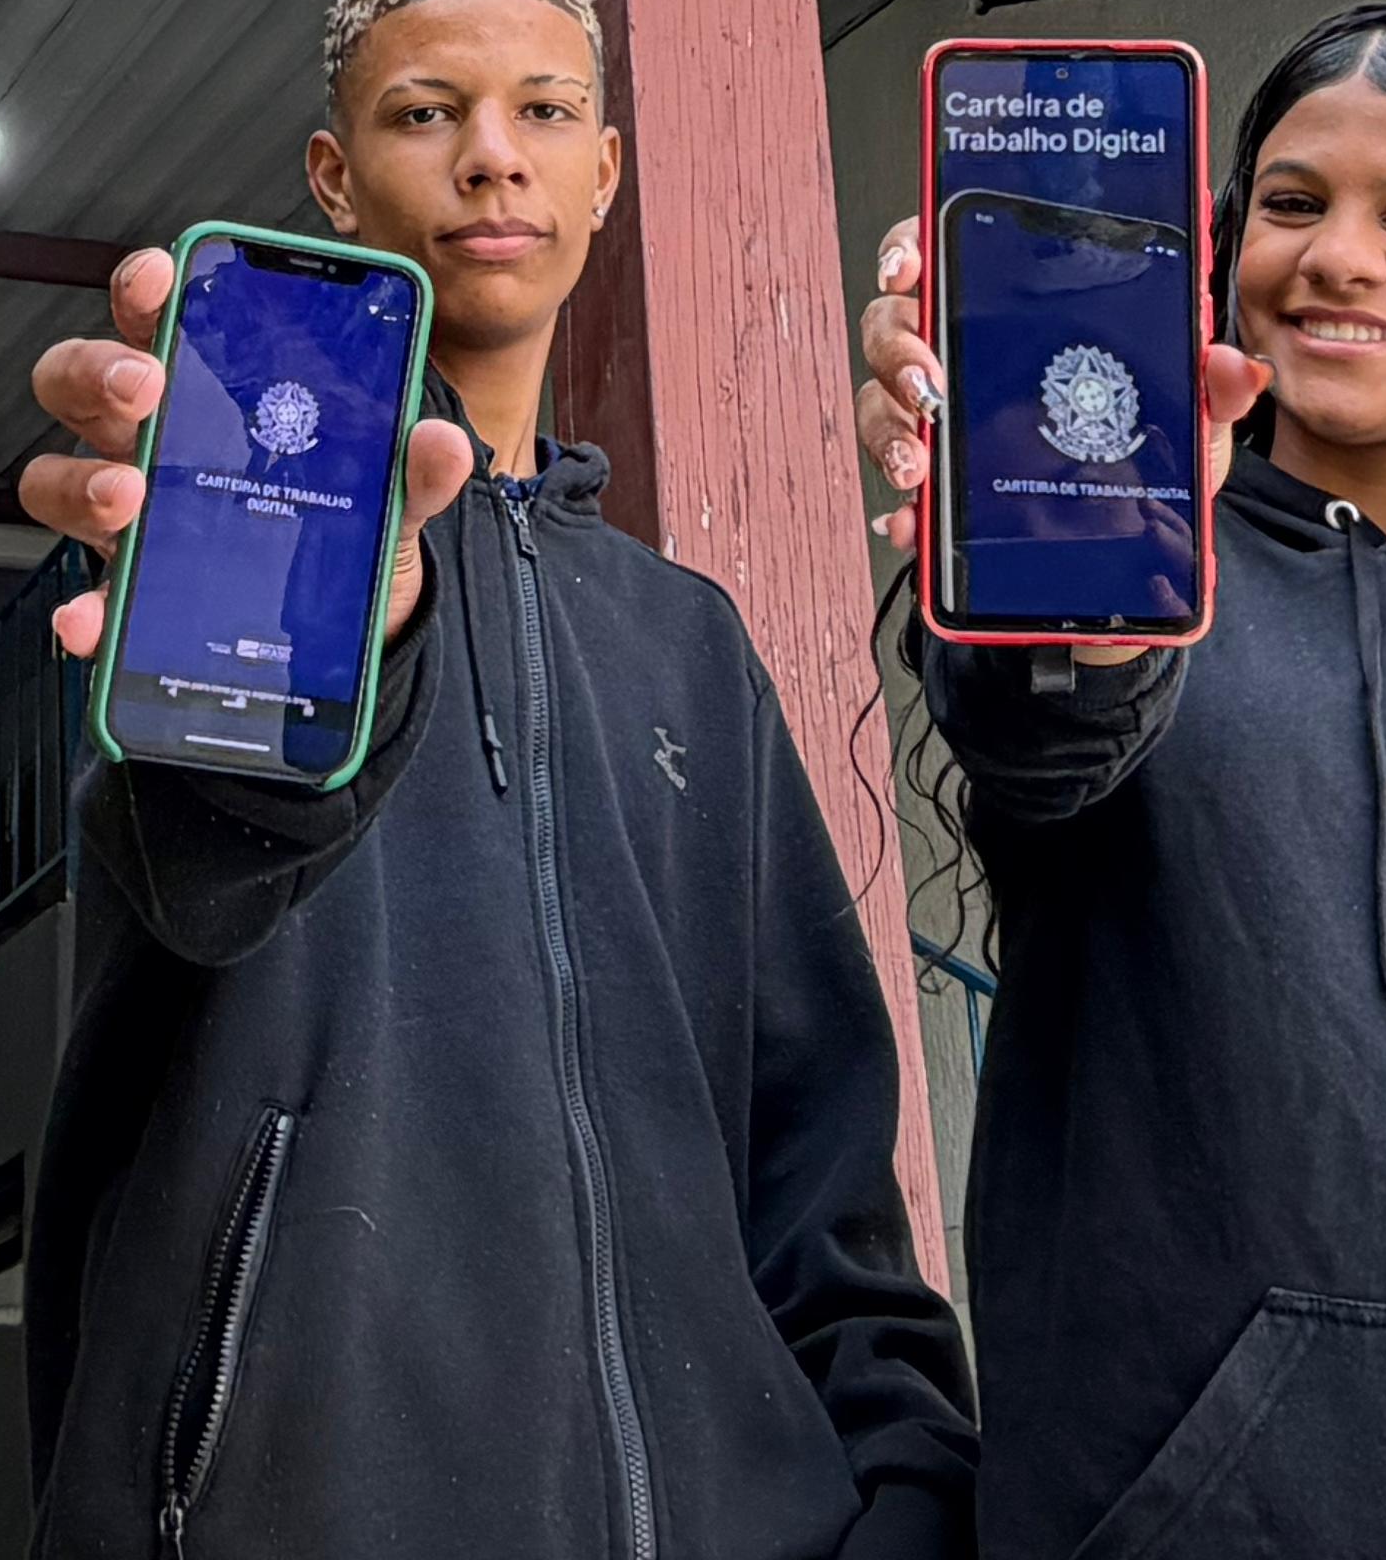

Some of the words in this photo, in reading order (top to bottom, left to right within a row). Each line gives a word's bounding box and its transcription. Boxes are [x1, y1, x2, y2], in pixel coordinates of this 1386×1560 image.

[945, 91, 1061, 118] Carteira
[1065, 92, 1105, 118] de
[944, 126, 1068, 153] Trabalho
[1072, 127, 1166, 160] Digital
[195, 472, 261, 496] CARTEIRA
[262, 483, 281, 499] DE
[283, 486, 353, 510] TRABALHO
[992, 478, 1059, 495] CARTEIRA
[1059, 481, 1079, 497] DE
[1079, 483, 1146, 499] TRABALHO
[246, 497, 299, 518] DIGITAL
